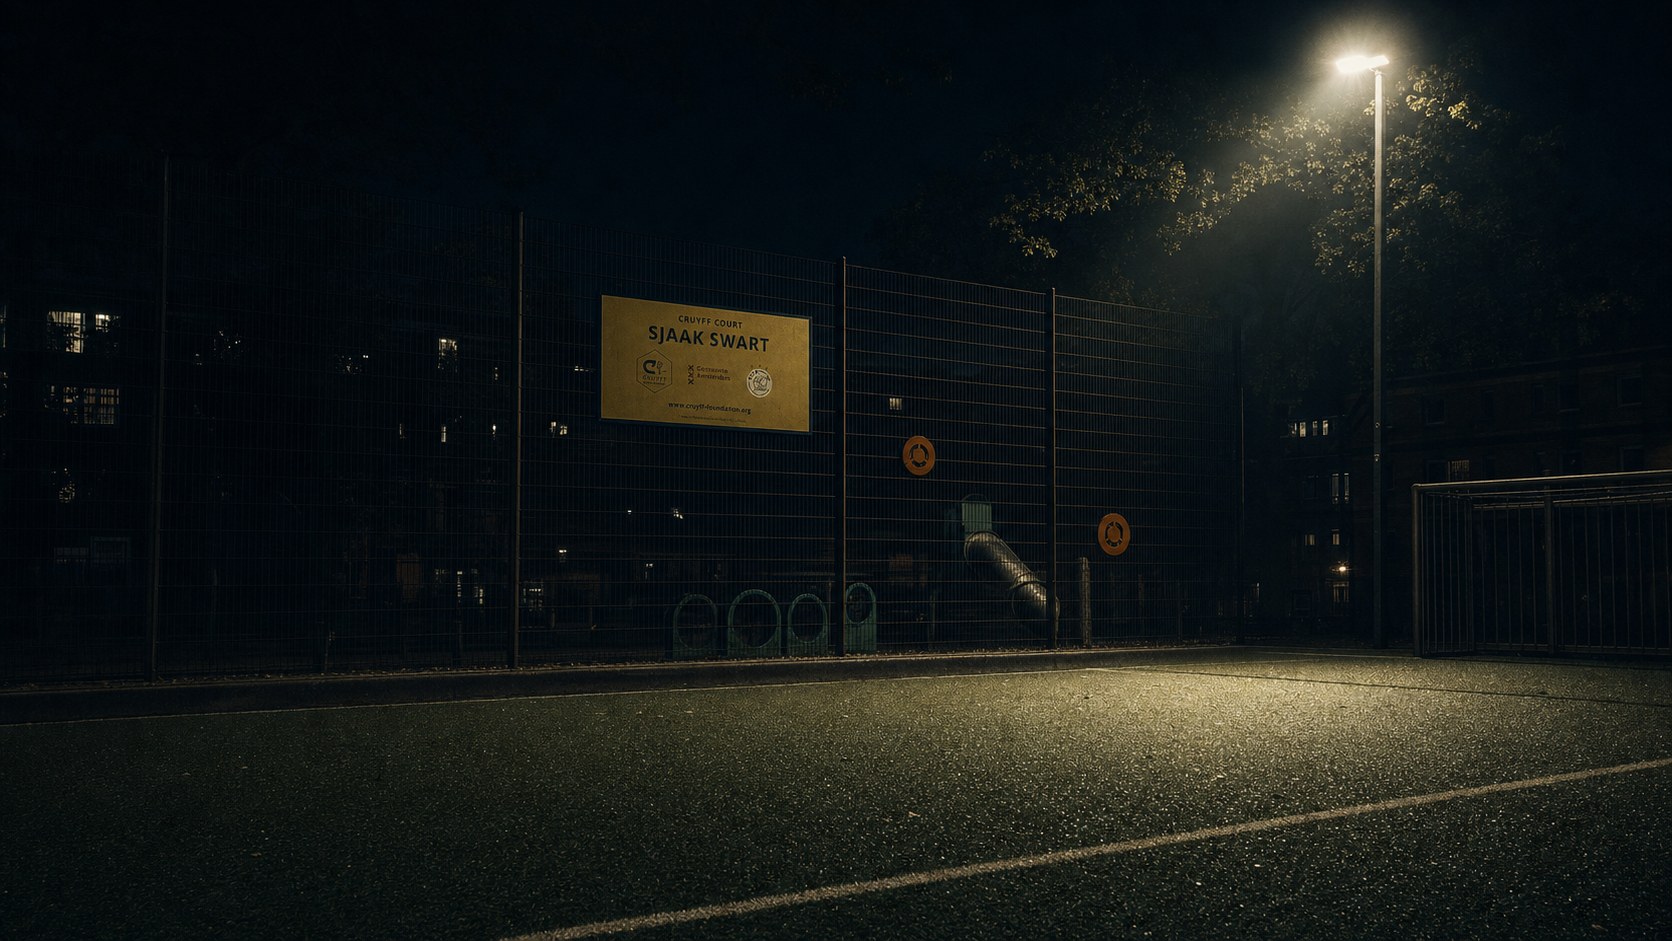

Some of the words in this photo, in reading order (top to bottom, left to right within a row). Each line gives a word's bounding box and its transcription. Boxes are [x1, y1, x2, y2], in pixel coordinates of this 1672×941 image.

[678, 315, 711, 325] CRUYFF
[714, 319, 743, 329] COURT
[648, 326, 704, 345] SJAAK
[710, 332, 769, 352] SWART
